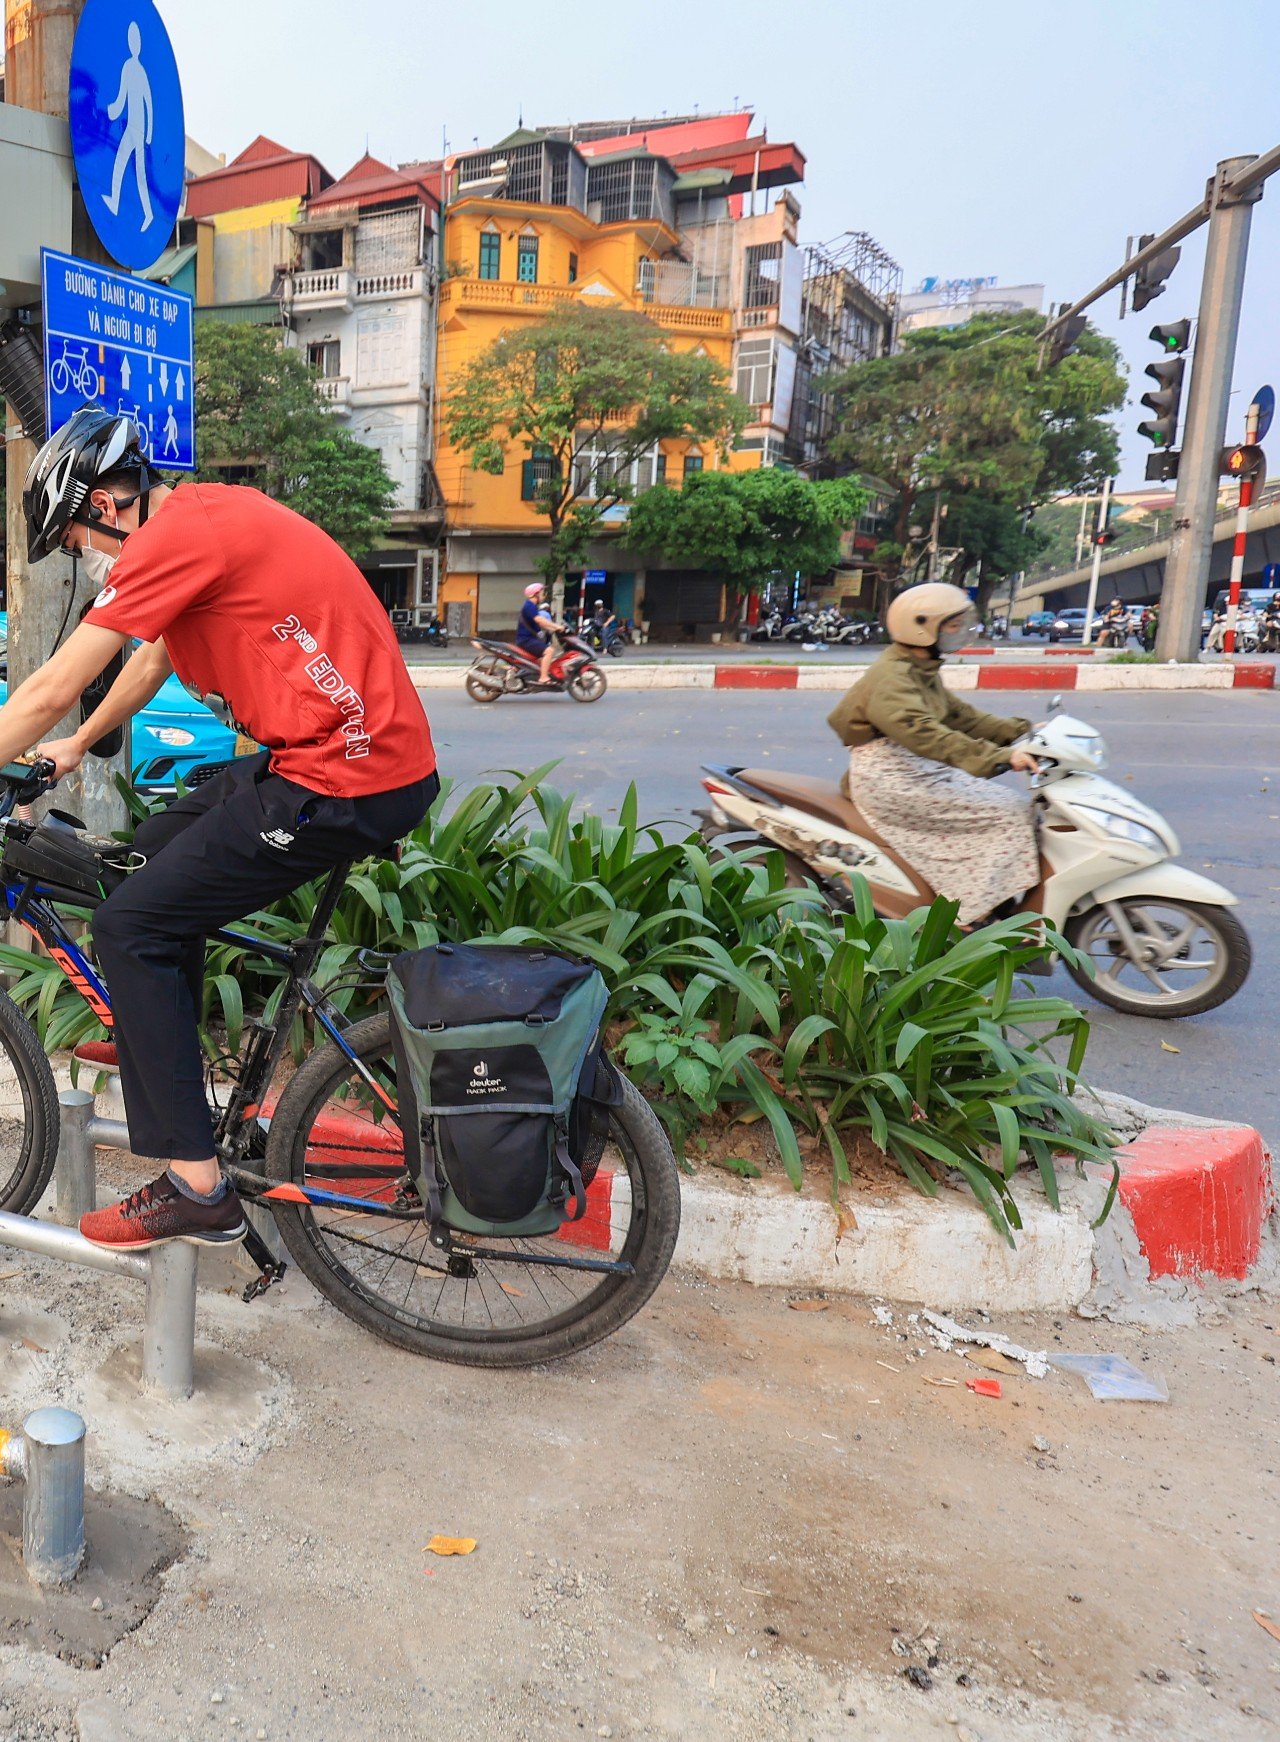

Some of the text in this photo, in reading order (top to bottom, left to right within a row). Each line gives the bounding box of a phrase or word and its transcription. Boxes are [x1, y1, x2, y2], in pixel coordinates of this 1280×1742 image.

[65, 267, 178, 327] ĐƯỜNG DÀNH CHO XE ĐẠP
[88, 305, 157, 353] VÀ NGƯỜI ĐI BỘ
[470, 1078, 501, 1087] deuter
[451, 1246, 476, 1257] GIANT
